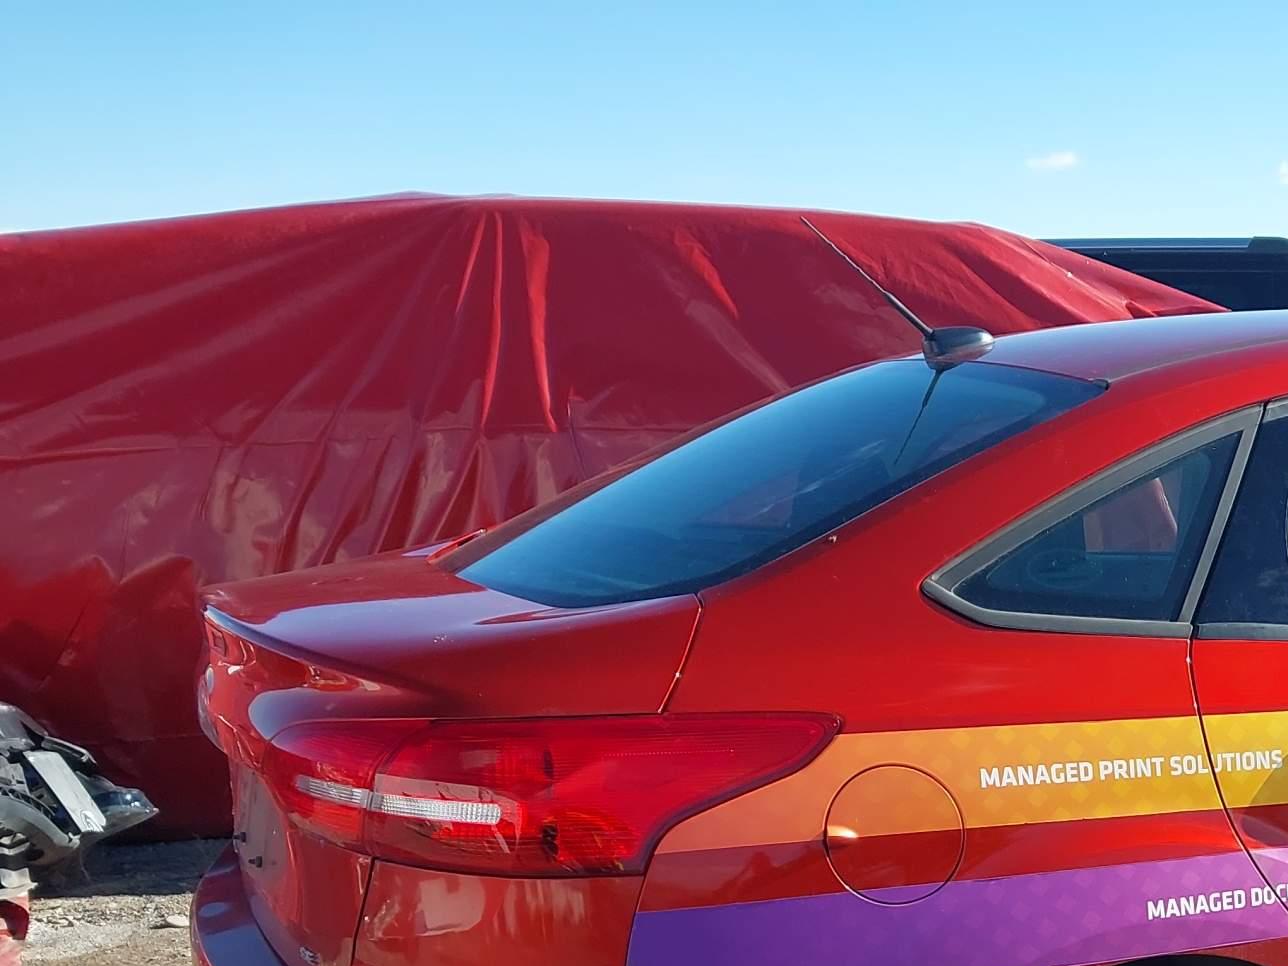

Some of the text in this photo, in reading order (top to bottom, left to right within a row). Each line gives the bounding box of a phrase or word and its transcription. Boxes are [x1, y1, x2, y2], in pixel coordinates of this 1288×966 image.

[980, 749, 1283, 788] MANAGED PRINT SOLUTIONS
[1147, 889, 1246, 920] MANAGED
